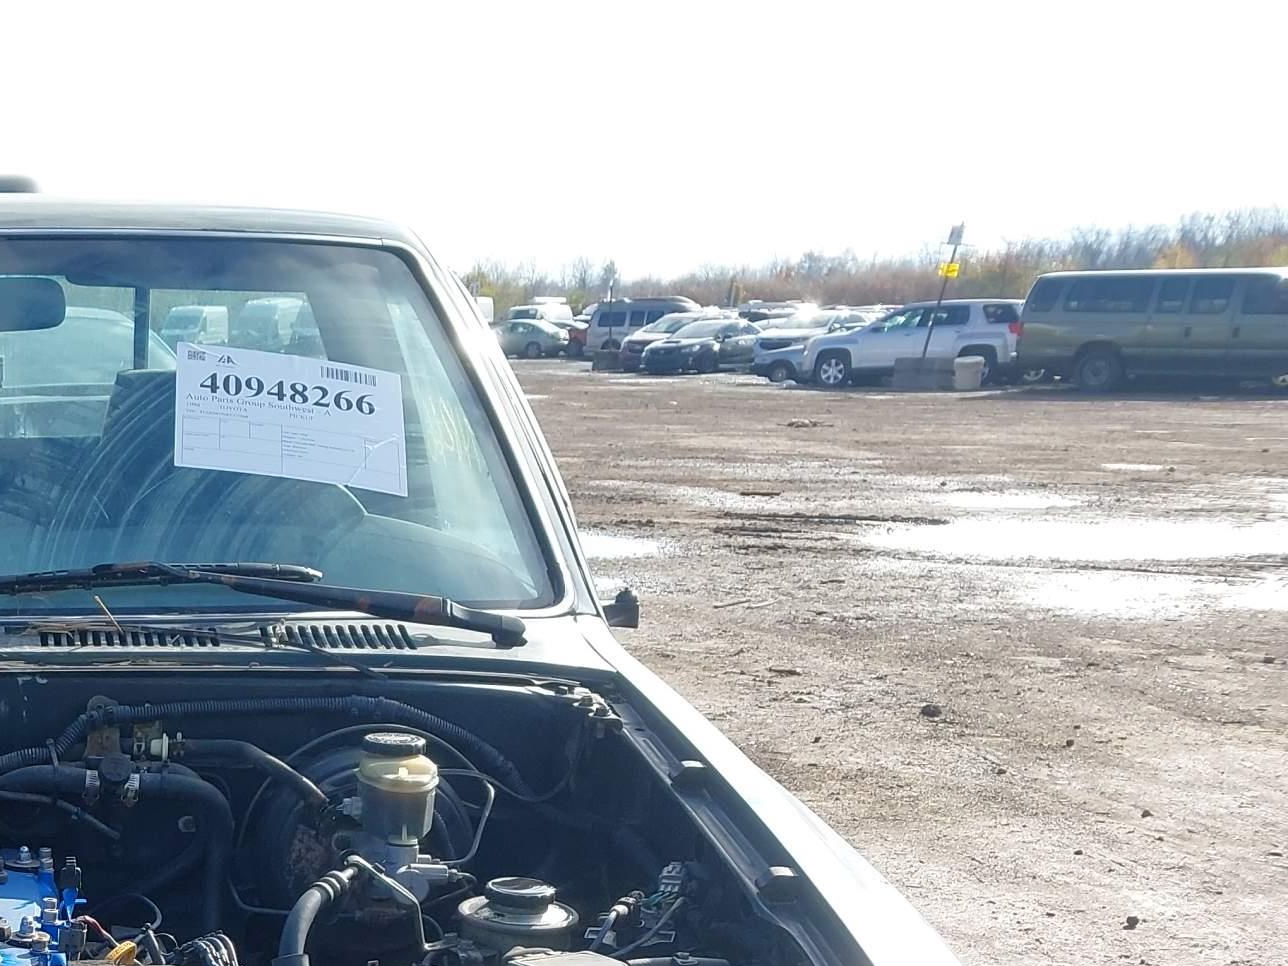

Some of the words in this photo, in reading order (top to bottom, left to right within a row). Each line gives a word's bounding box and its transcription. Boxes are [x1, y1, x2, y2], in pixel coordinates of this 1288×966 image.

[186, 393, 209, 401] Auto
[212, 395, 234, 404] Parts
[237, 397, 265, 408] Group
[268, 402, 314, 414] Southwest
[199, 371, 376, 417] 40948266
